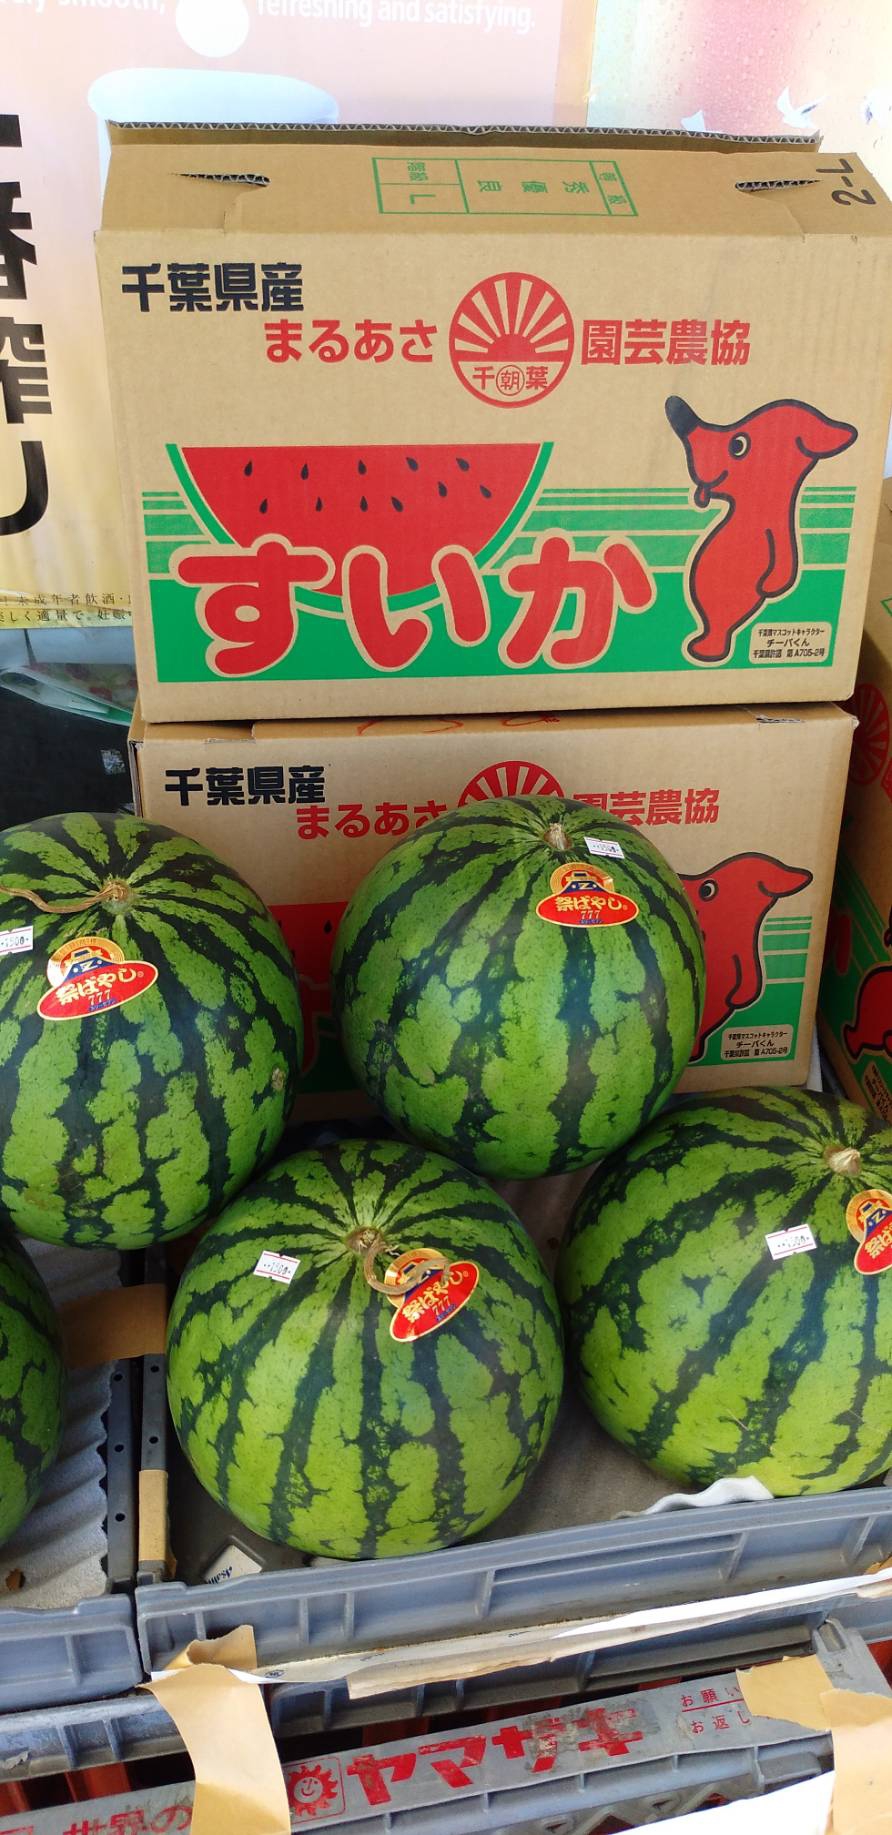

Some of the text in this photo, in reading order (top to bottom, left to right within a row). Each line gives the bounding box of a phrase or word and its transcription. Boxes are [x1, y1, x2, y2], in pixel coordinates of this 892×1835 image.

[377, 0, 420, 22] and
[423, 0, 536, 34] satisfying.
[121, 262, 304, 313] 千葉県産
[263, 318, 751, 366] まるあさ 園芸農協
[173, 535, 655, 677] すいか
[767, 638, 810, 648] チーバくん
[164, 765, 326, 807] 千葉県産
[555, 895, 622, 912] 祭ばやし
[580, 910, 601, 920] 777
[55, 968, 137, 1006] 祭ばやし
[736, 1040, 775, 1049] チーバくん
